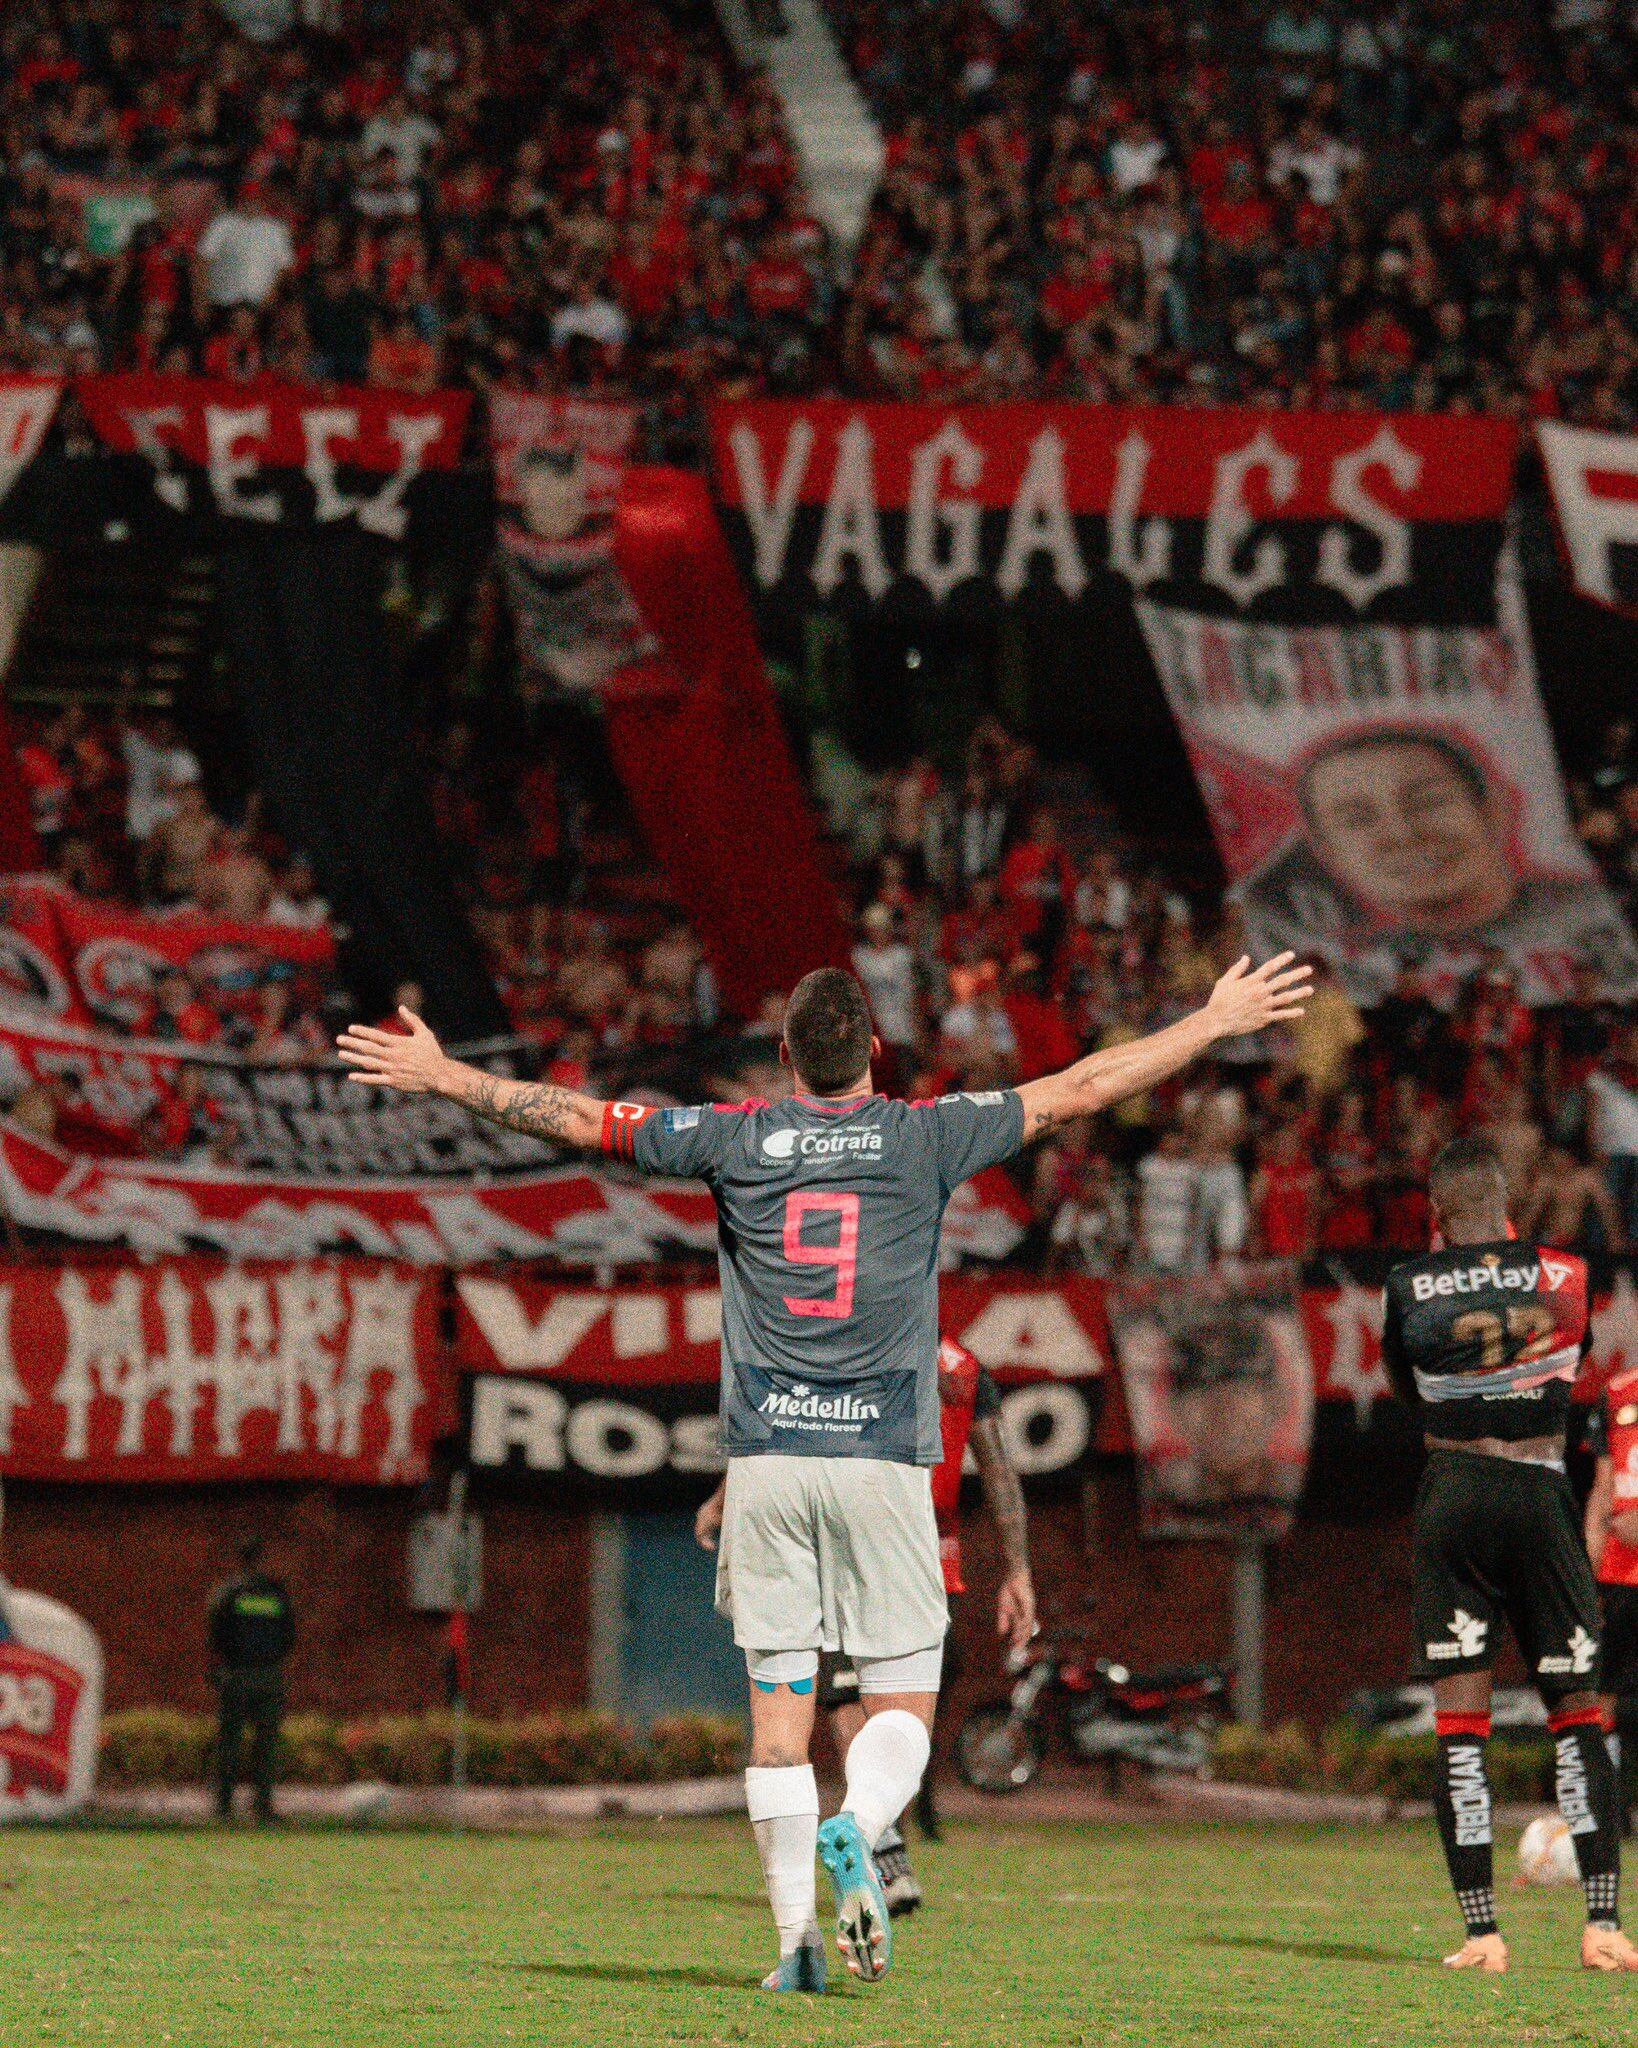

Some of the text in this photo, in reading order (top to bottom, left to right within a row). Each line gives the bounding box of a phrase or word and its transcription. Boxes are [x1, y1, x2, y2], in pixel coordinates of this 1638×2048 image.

[800, 1133, 882, 1154] Cotrafa
[782, 1191, 860, 1319] 9
[1412, 1264, 1540, 1301] BetPlay
[758, 1391, 880, 1420] Medellín
[771, 1418, 863, 1432] Aquí todo florece
